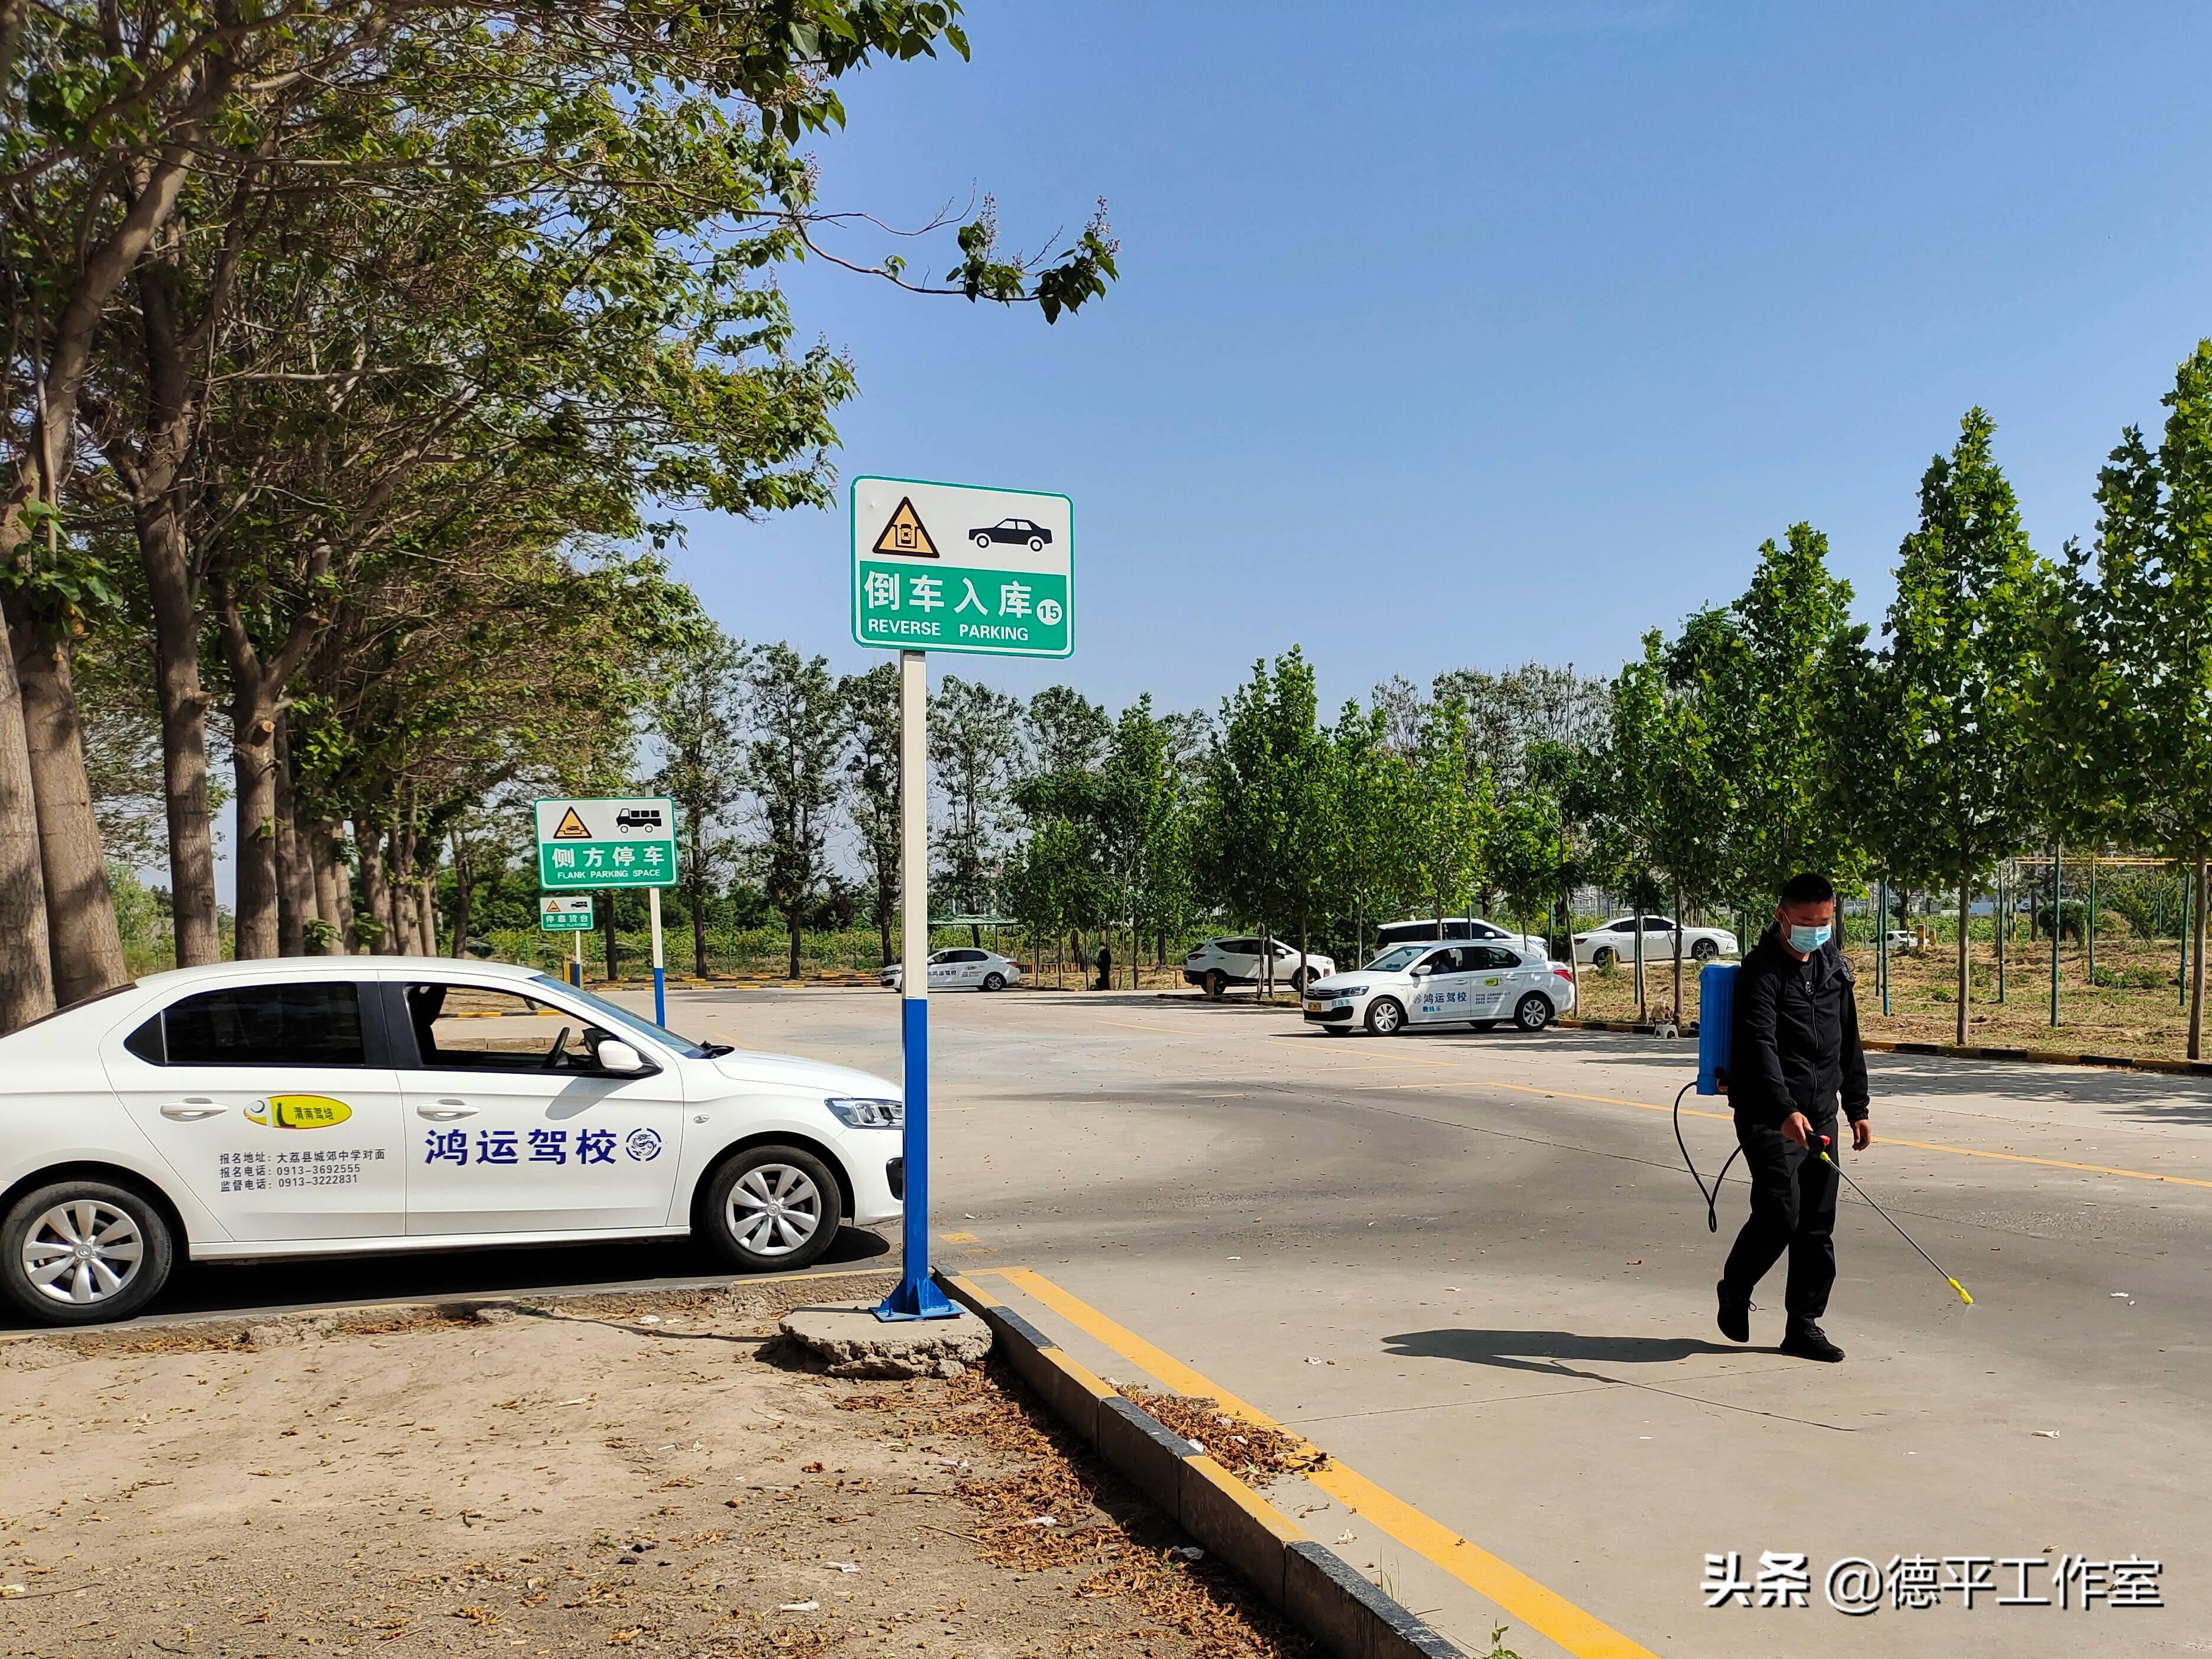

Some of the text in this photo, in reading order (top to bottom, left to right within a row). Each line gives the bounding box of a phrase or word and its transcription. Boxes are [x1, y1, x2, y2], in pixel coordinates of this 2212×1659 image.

[864, 570, 1060, 620] 倒车入库 15
[868, 618, 1029, 641] REVERSE PARKING
[551, 845, 665, 869] 侧方停车
[590, 870, 629, 879] PARKING
[632, 869, 661, 877] SPACE
[1423, 992, 1467, 1004] 鸿运驾校
[424, 1128, 617, 1166] 鸿运驾校
